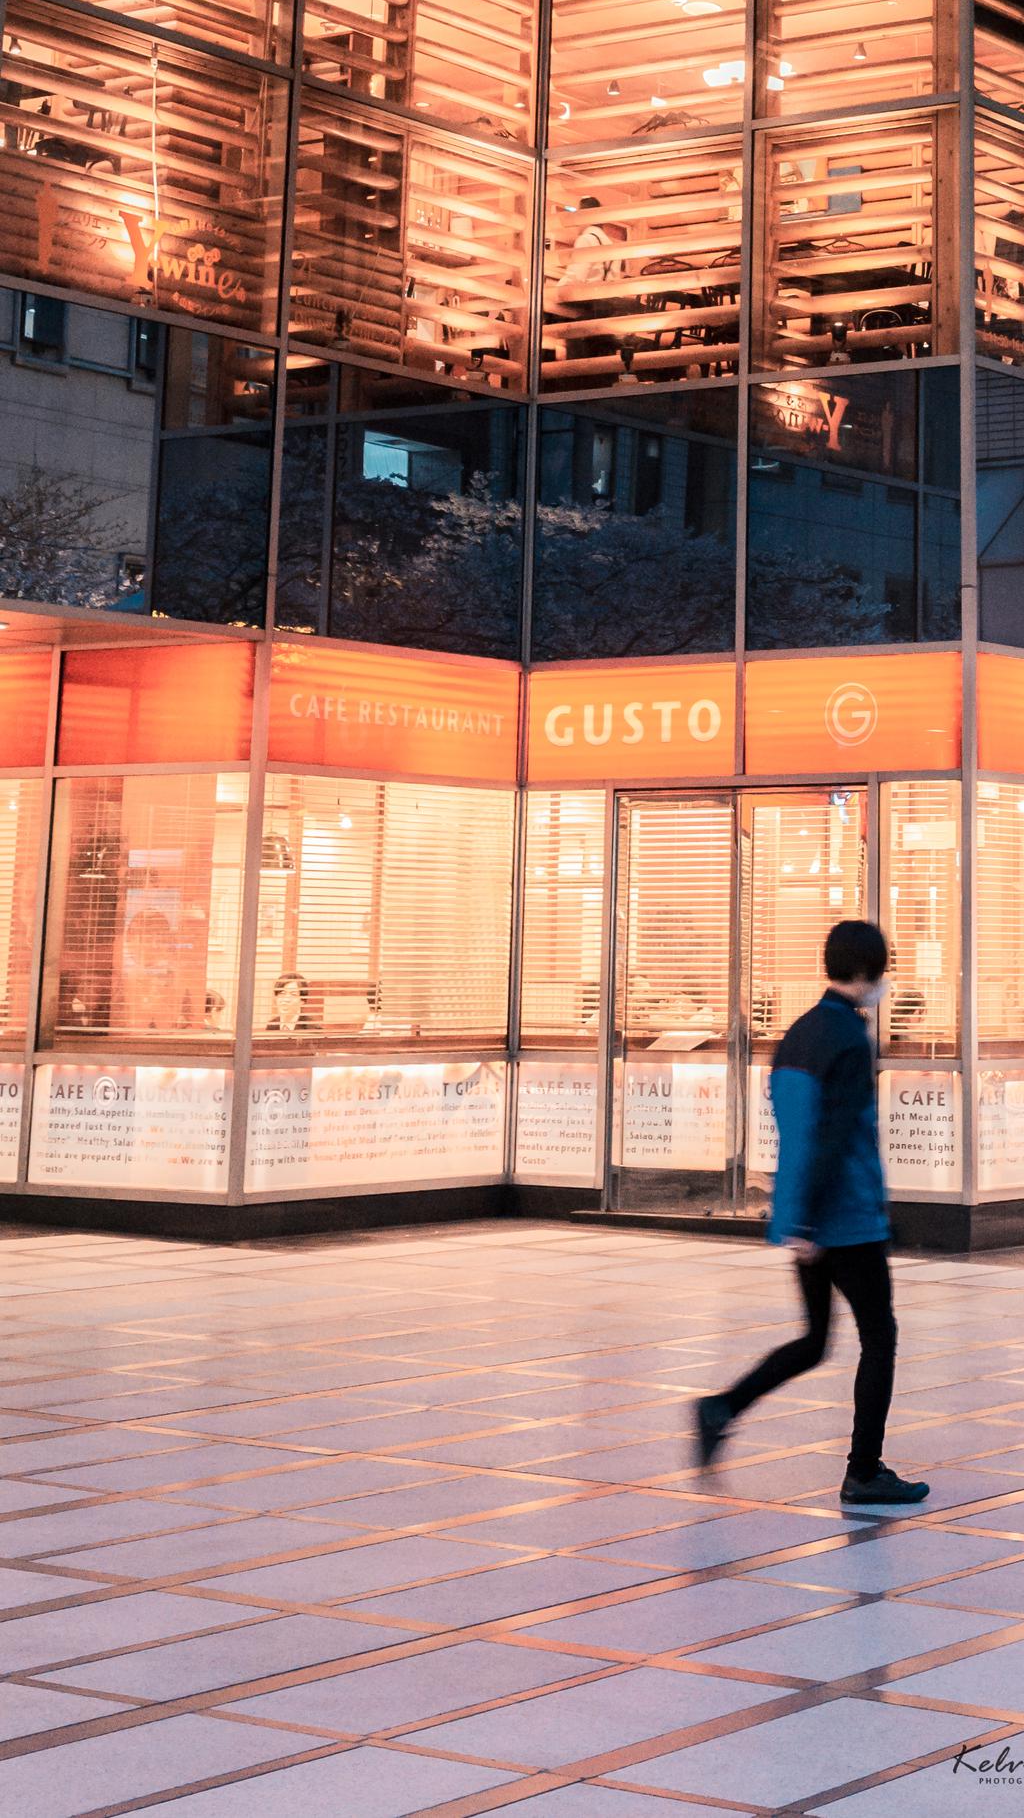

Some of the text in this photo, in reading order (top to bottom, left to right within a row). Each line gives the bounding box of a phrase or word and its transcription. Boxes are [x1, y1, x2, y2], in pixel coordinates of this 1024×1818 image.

[358, 699, 505, 737] RESTAURANT
[830, 689, 873, 740] G
[544, 699, 722, 747] GUSTO
[908, 1113, 933, 1122] Meal
[935, 1113, 955, 1122] and
[909, 1127, 945, 1138] please
[928, 1142, 955, 1154] Light
[933, 1157, 956, 1168] plea
